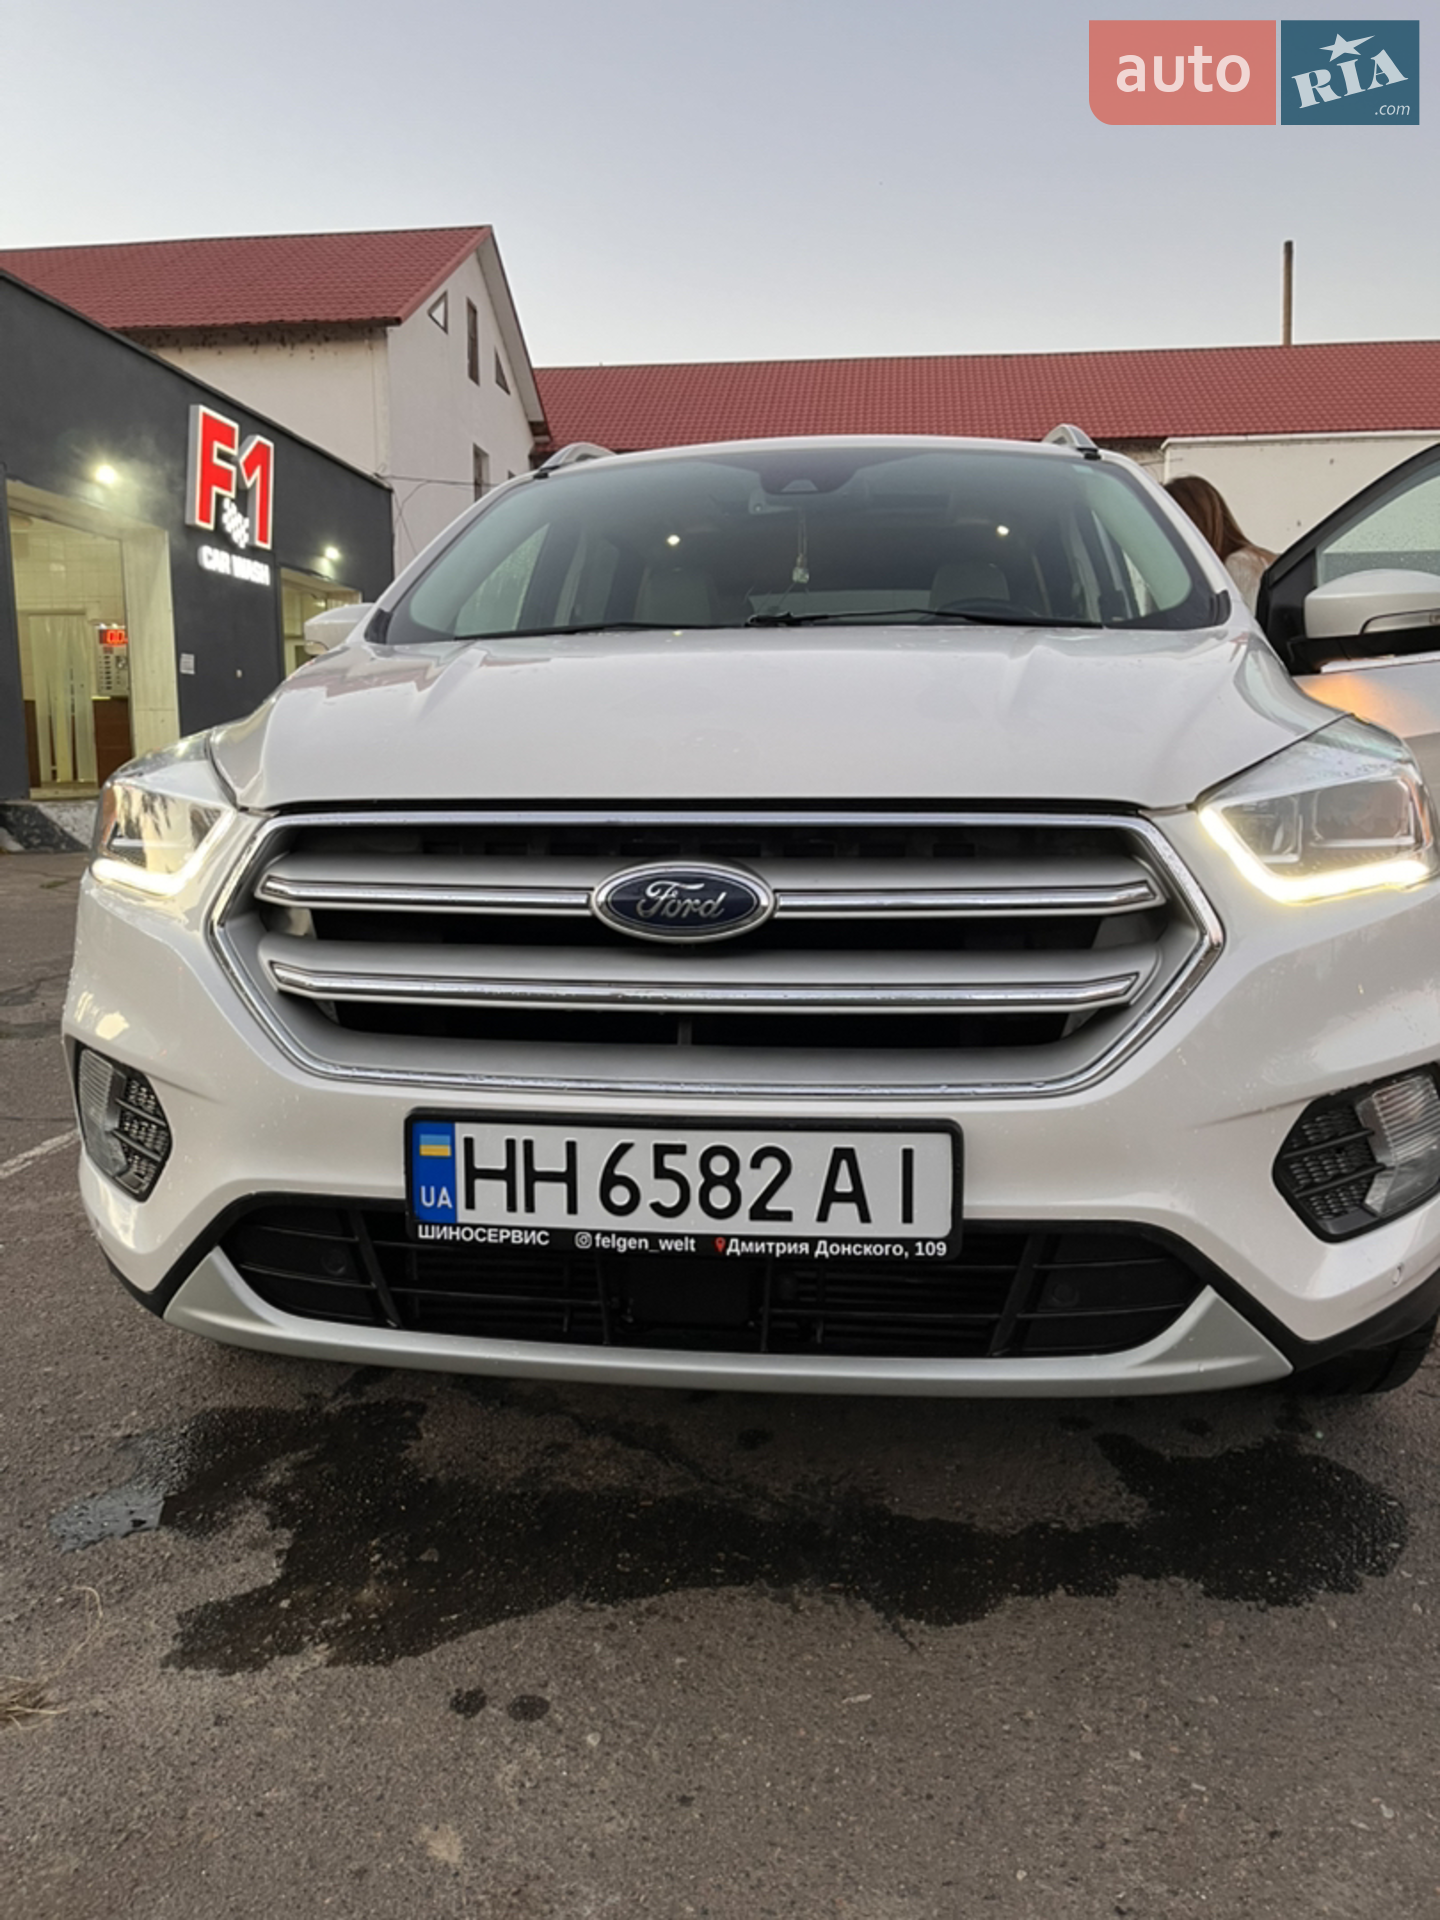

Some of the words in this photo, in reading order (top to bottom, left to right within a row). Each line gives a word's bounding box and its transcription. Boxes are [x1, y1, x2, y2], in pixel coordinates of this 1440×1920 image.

[190, 405, 274, 550] F1
[199, 545, 231, 575] CAR
[231, 554, 271, 586] WASH
[635, 880, 728, 919] Ford
[420, 1185, 453, 1209] UA
[599, 1142, 794, 1223] 6582
[418, 1224, 550, 1246] ШИНОСЕРВИС
[594, 1233, 696, 1253] felgen_welt
[726, 1238, 810, 1257] Дмитрия
[814, 1240, 910, 1259] Донского,
[914, 1241, 947, 1256] 109
